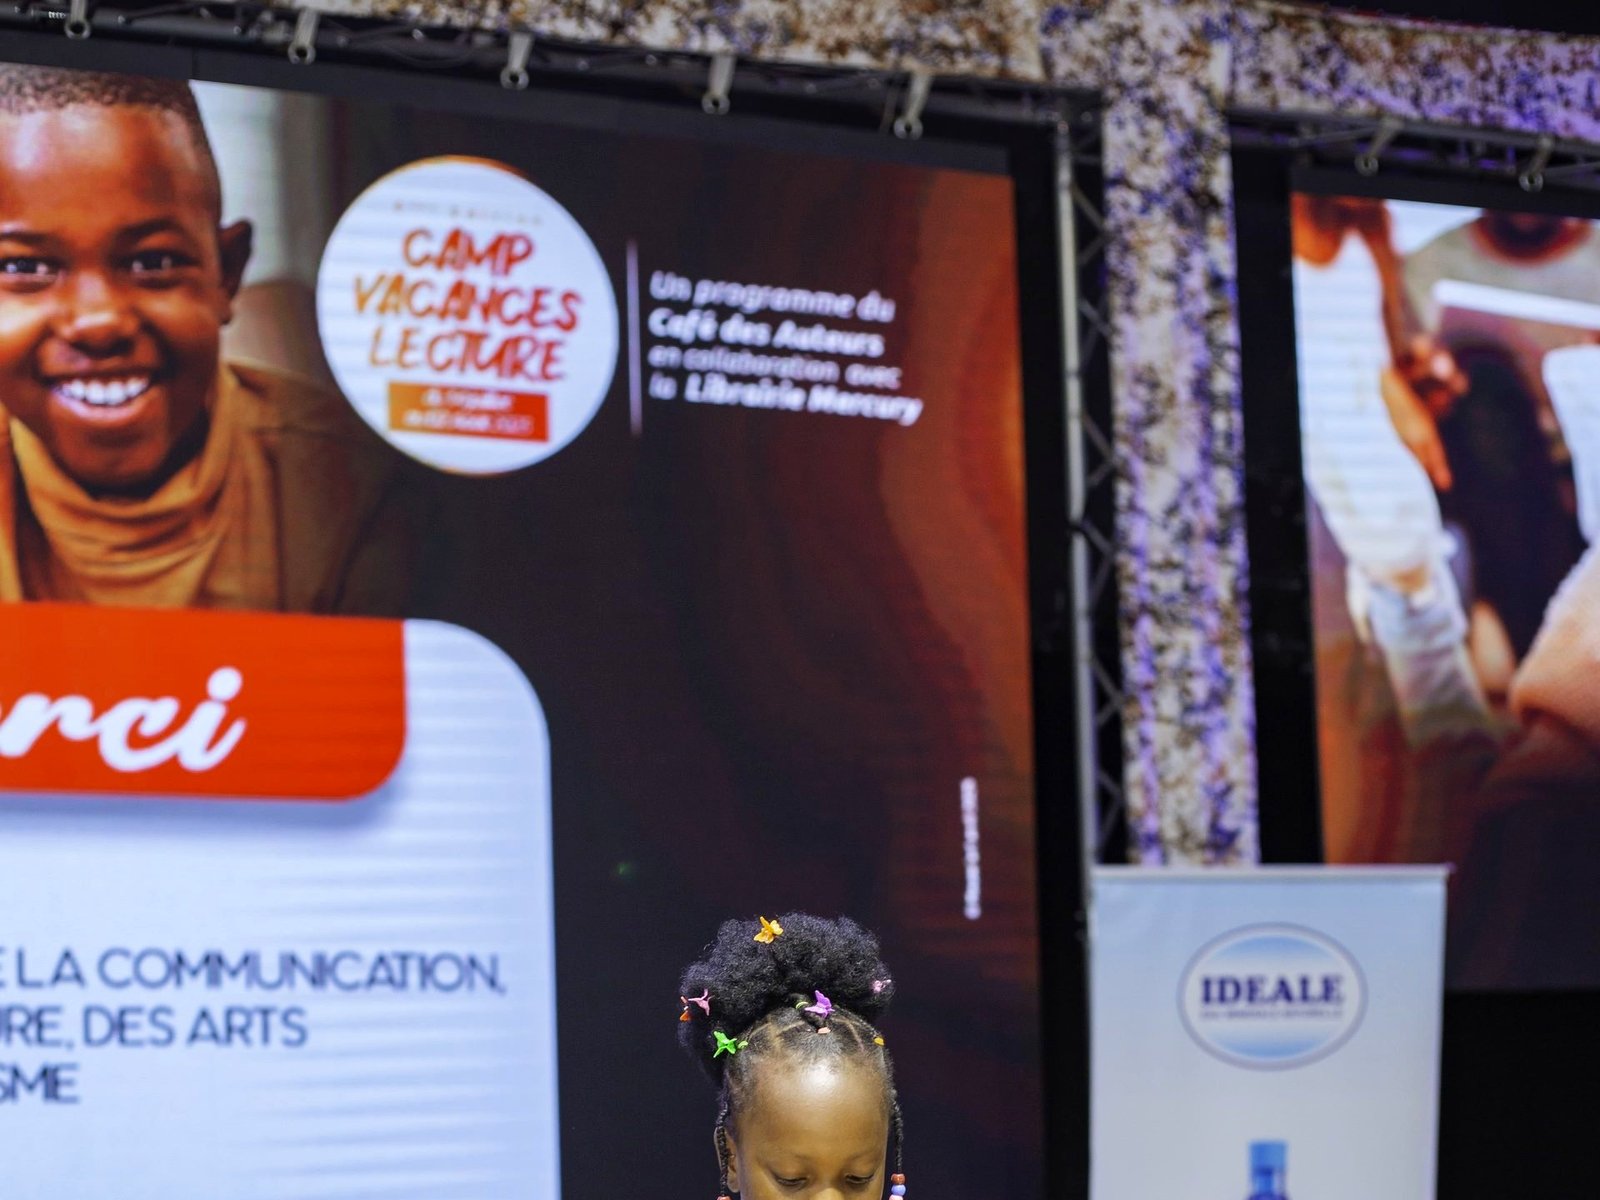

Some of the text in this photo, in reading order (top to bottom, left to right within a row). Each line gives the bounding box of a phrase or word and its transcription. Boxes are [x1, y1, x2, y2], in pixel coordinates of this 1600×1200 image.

[402, 227, 534, 276] CAMP
[355, 272, 583, 332] VACANCES
[649, 269, 895, 322] Un programme du
[369, 325, 565, 382] LECTURE
[648, 307, 884, 357] Café des Auteurs
[682, 346, 840, 384] collaboration
[845, 363, 902, 390] avec
[685, 372, 806, 411] Librairie
[807, 384, 924, 426] Mercury
[15, 946, 507, 995] LA COMMUNICATION,
[1202, 974, 1345, 1005] IDEALE
[83, 1005, 175, 1047] DES
[186, 1006, 309, 1047] ARTS
